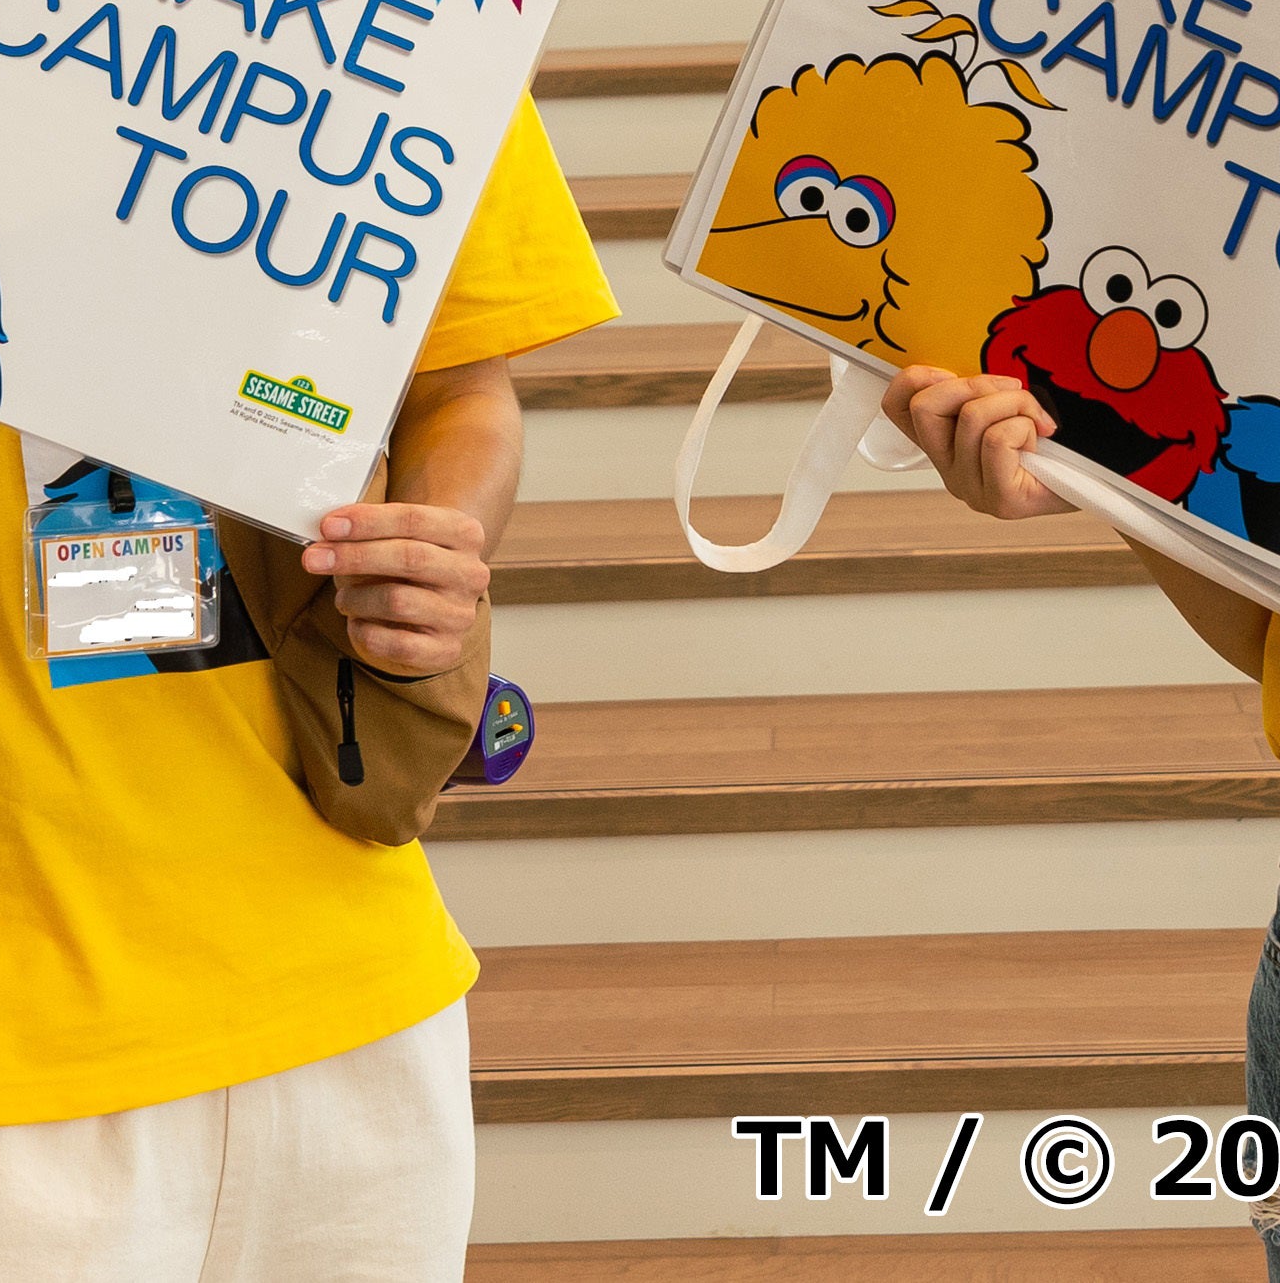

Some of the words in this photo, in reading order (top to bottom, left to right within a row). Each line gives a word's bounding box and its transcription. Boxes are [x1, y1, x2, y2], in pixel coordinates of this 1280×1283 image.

[114, 124, 418, 324] TOUR
[246, 376, 299, 410] SESAME
[297, 395, 347, 428] STREET
[296, 379, 310, 390] 123
[57, 541, 105, 562] OPEN
[112, 534, 184, 557] CAMPUS
